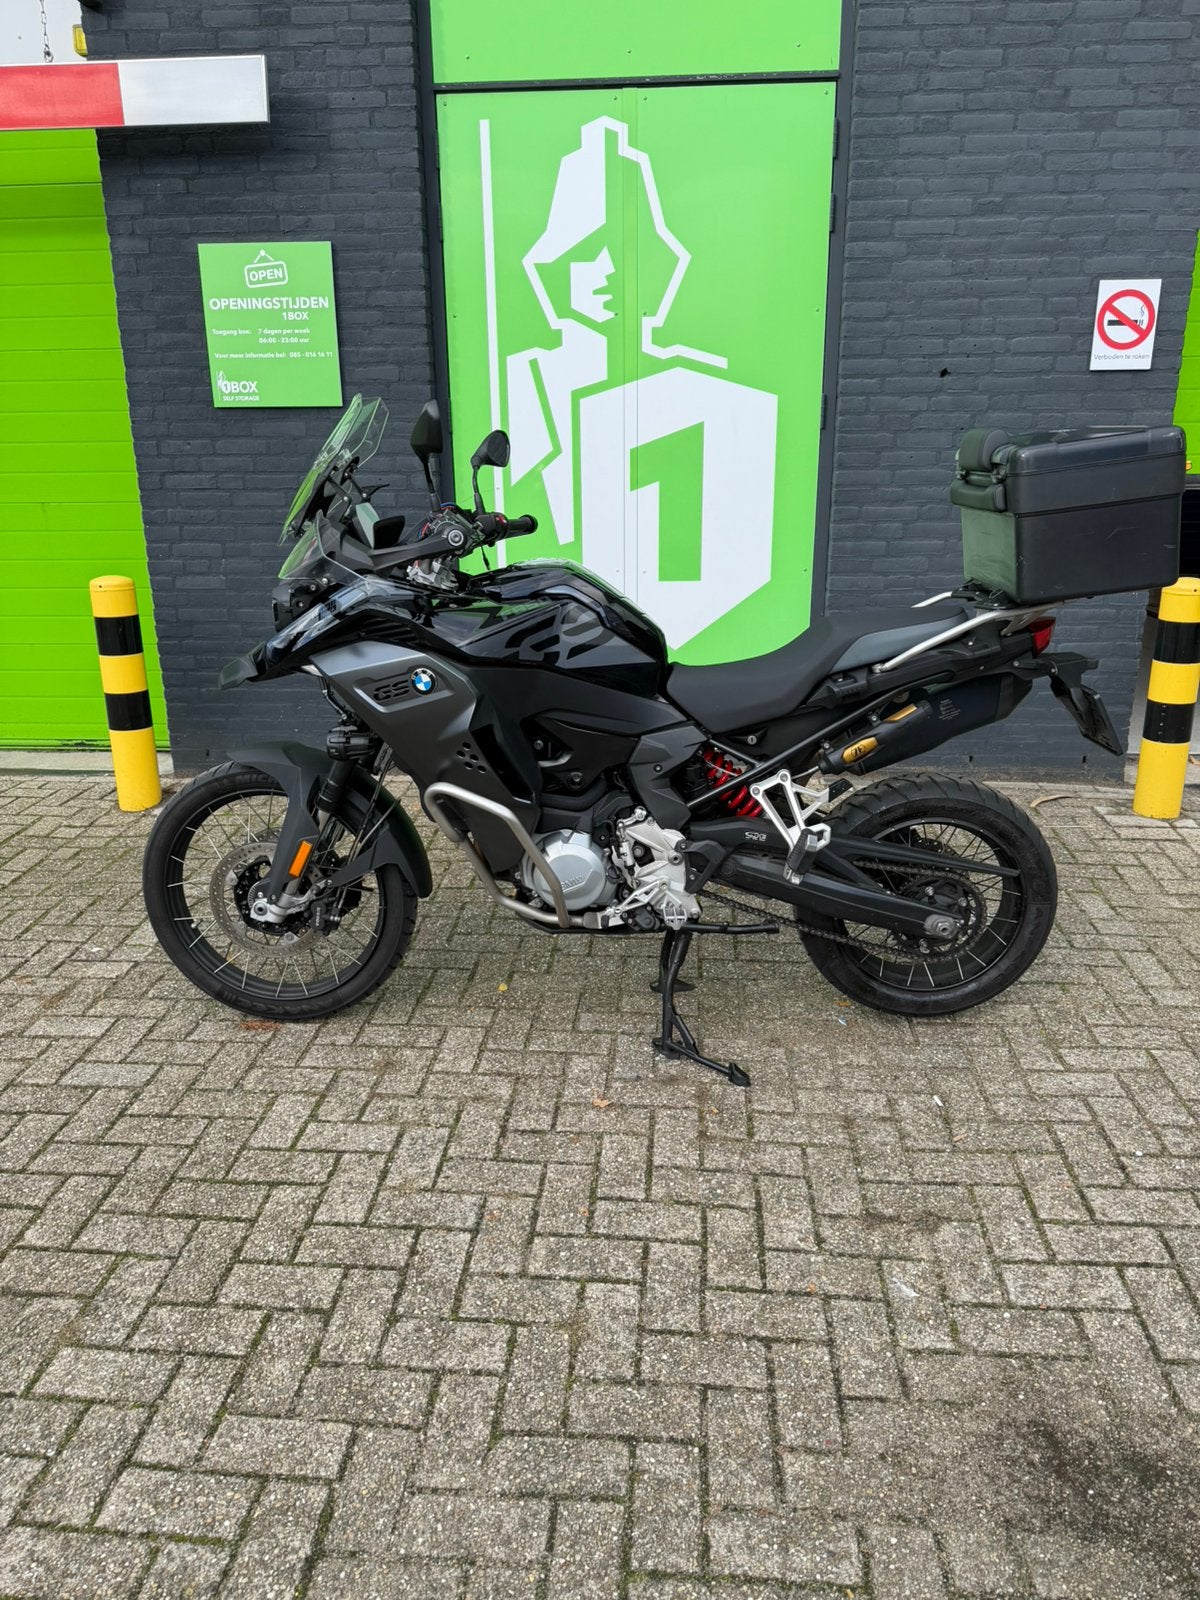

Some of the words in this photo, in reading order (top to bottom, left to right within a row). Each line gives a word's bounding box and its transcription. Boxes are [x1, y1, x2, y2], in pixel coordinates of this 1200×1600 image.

[249, 268, 283, 281] OPEN
[209, 297, 329, 310] OPENINGSTIJDEN
[282, 311, 309, 320] 1BOX
[212, 328, 237, 336] Toegang
[373, 679, 410, 701] GS
